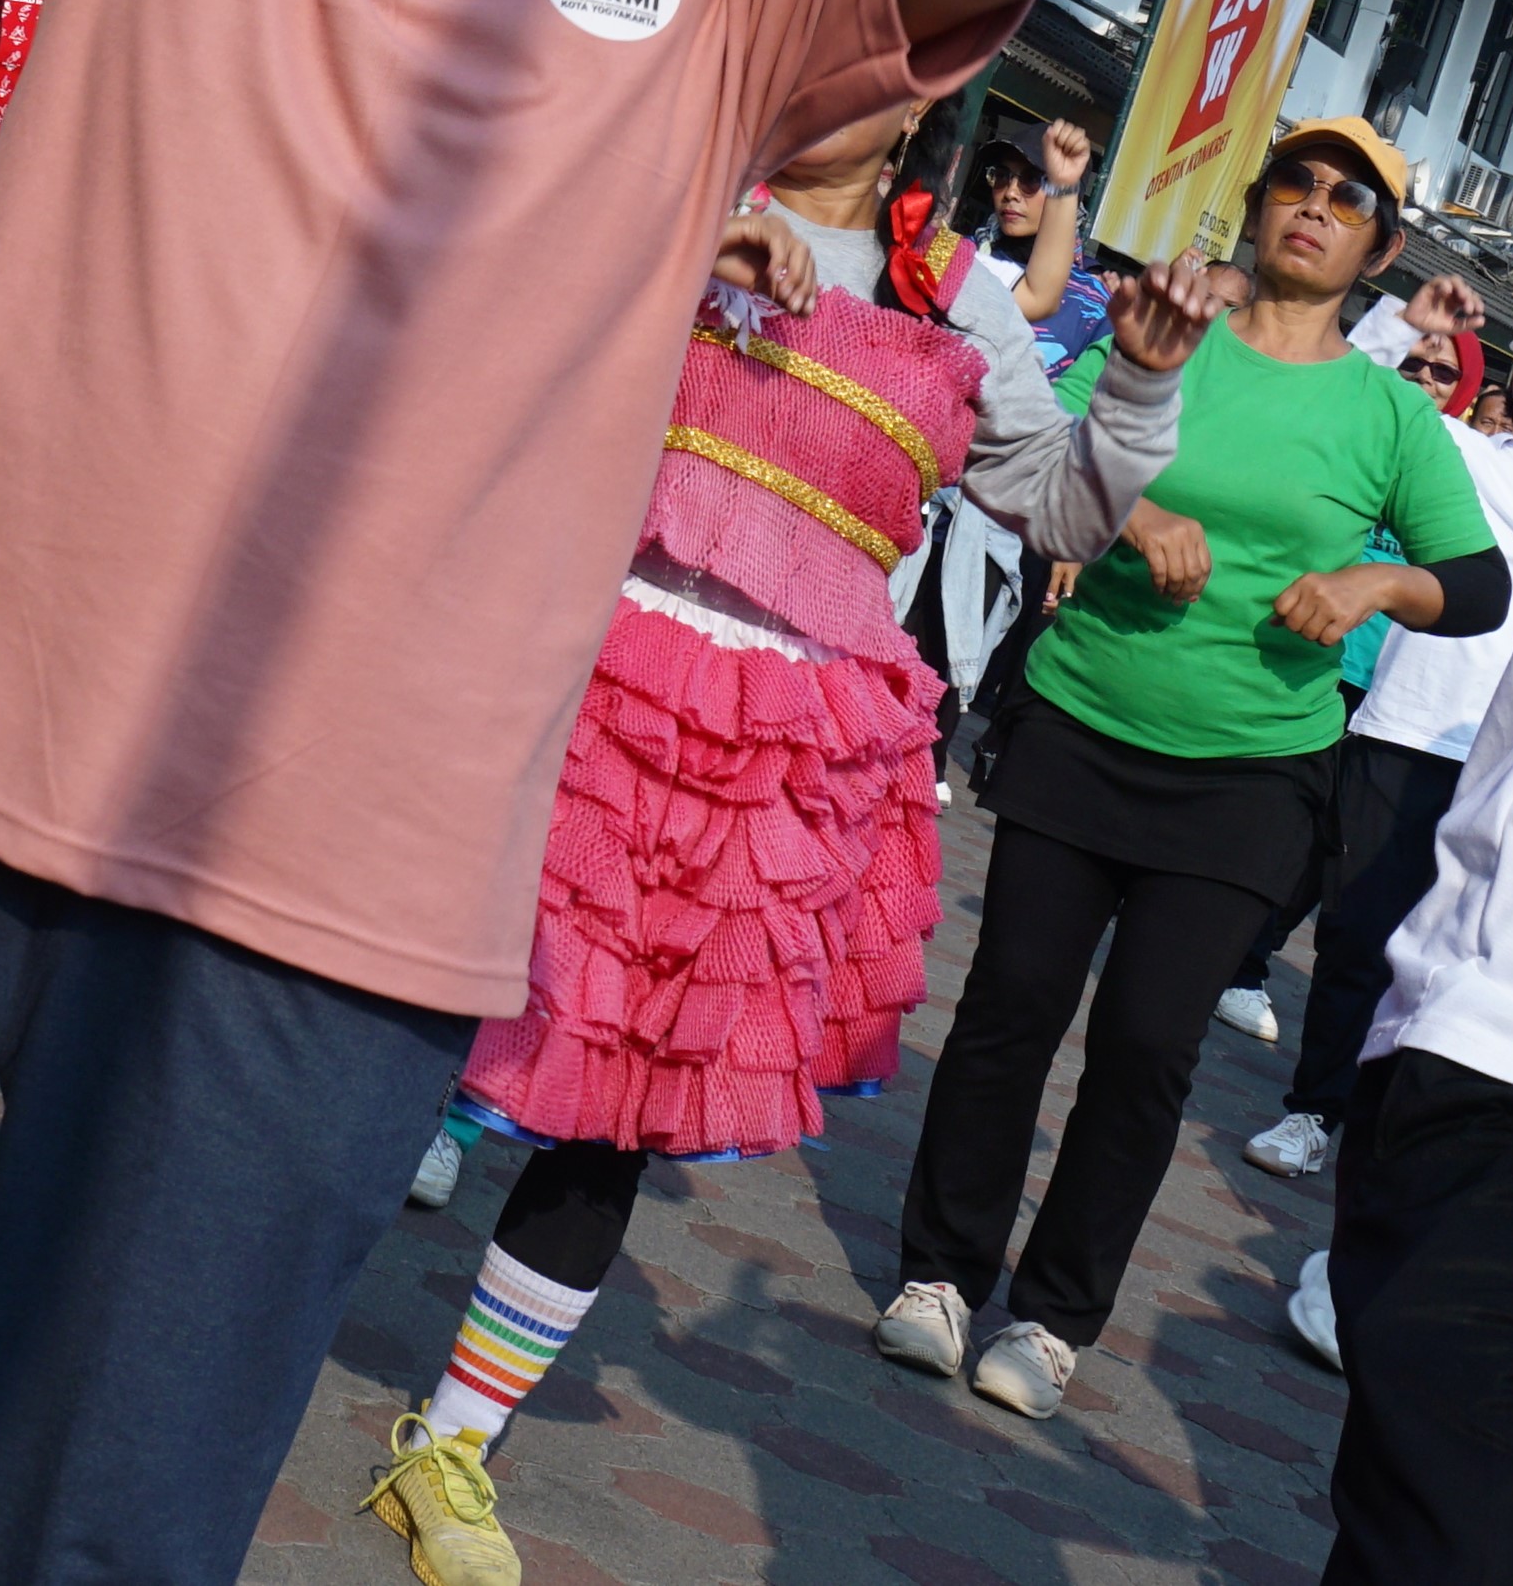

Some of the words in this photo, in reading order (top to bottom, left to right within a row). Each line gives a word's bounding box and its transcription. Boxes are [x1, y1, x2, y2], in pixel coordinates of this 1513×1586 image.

[560, 0, 588, 12] KOTA
[591, 4, 657, 28] YOGYAKARTA
[1144, 156, 1189, 202] OTENTIK
[1184, 128, 1234, 179] KONKRET
